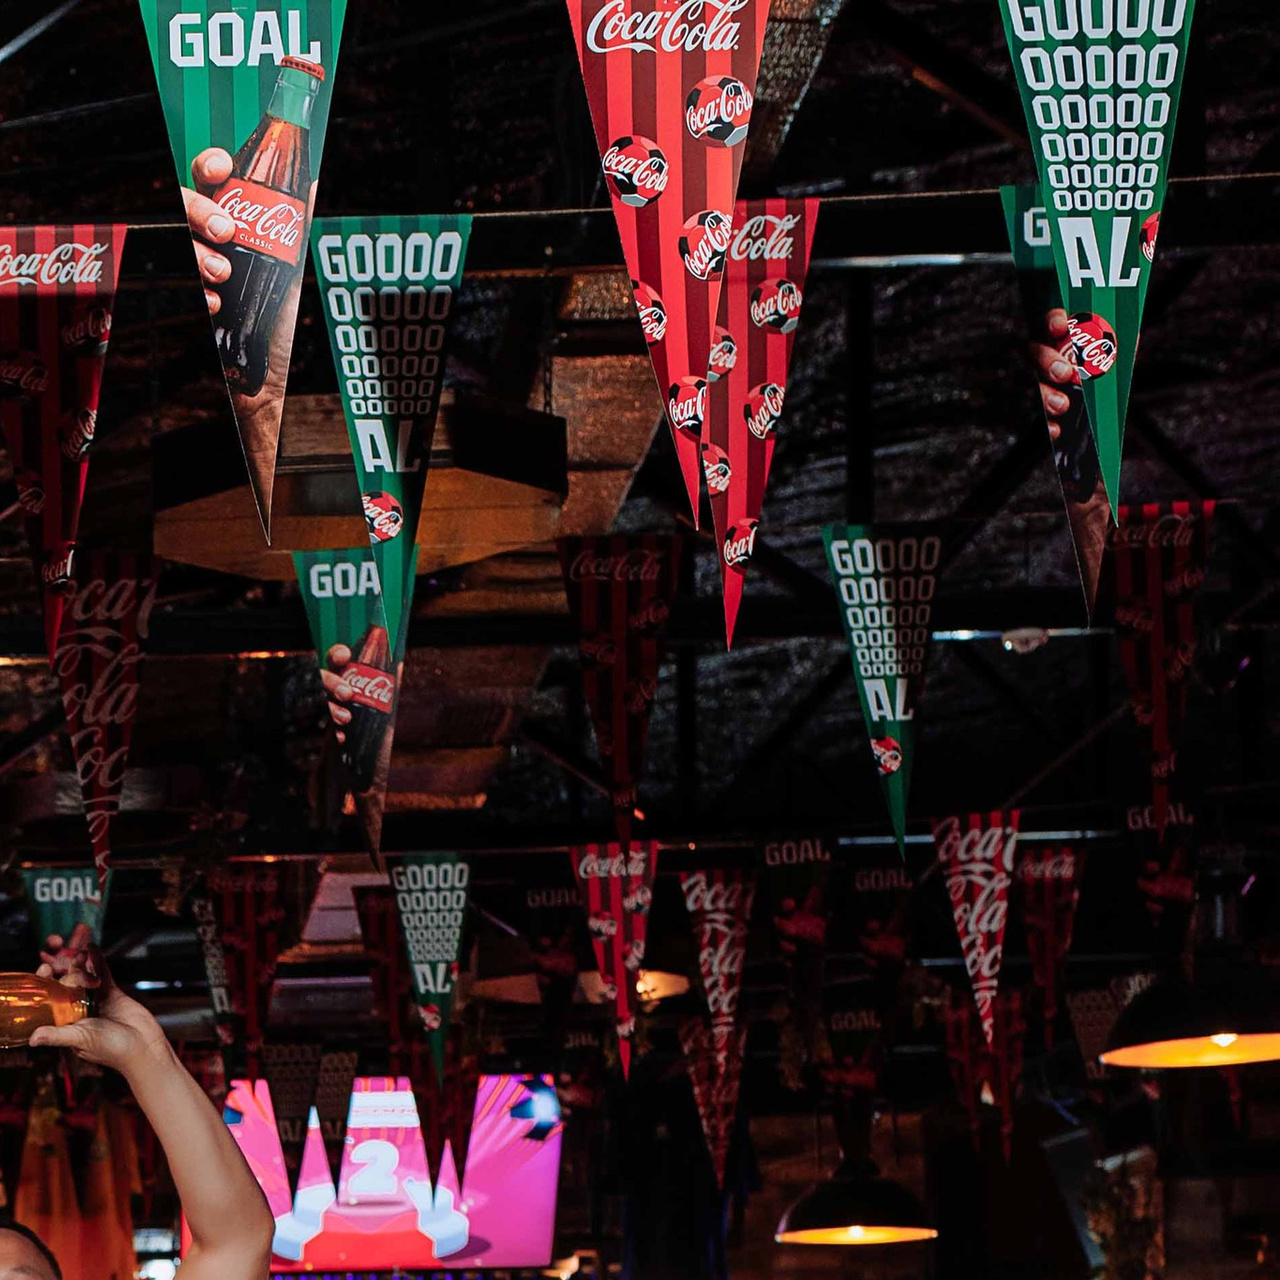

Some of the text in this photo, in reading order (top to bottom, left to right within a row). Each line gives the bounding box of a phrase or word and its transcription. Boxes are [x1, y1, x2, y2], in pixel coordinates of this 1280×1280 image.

[169, 10, 321, 67] GOAL
[586, 0, 748, 53] Coca-Cola
[218, 188, 304, 248] Coca-Cola
[240, 233, 273, 250] CLASSIC
[318, 231, 462, 282] GOOOO
[1057, 217, 1140, 287] AL
[354, 419, 420, 473] AL
[309, 561, 381, 598] GOA
[863, 678, 915, 722] AL
[765, 838, 831, 867] GOAL
[34, 877, 101, 902] GOAL
[413, 963, 451, 994] AL
[350, 1139, 400, 1194] 2
